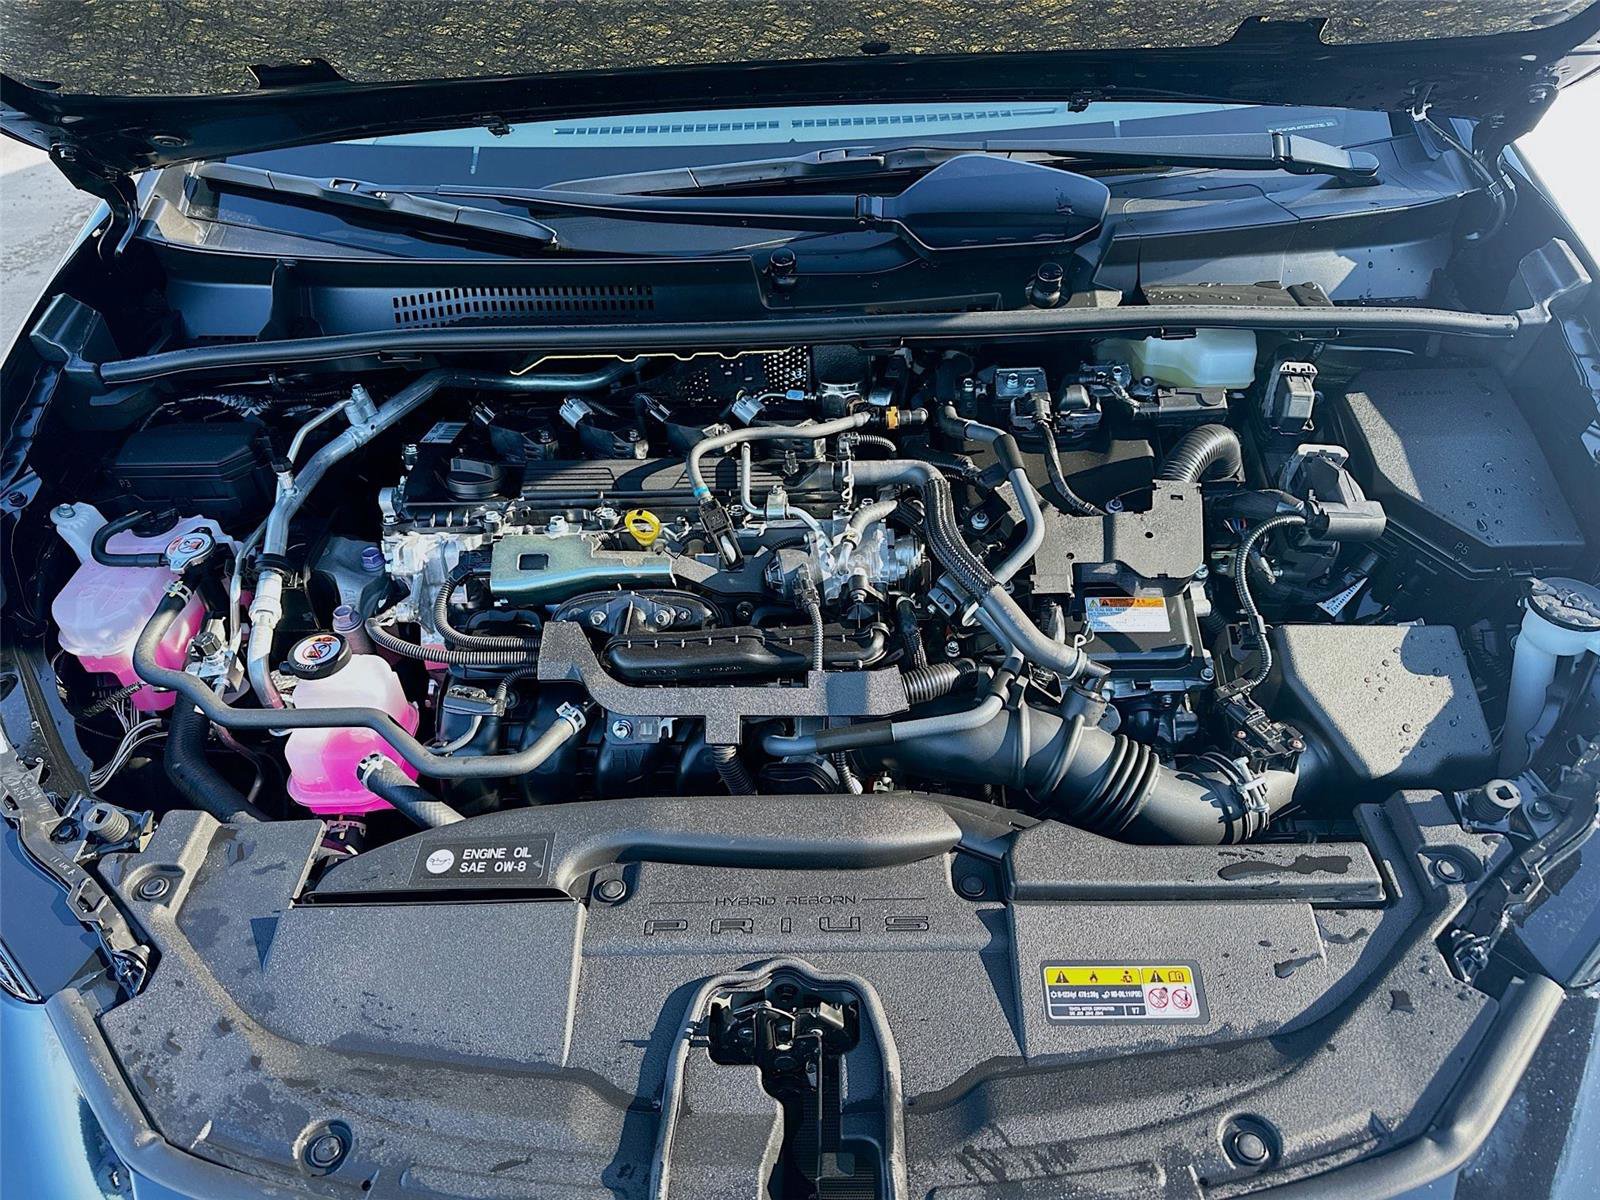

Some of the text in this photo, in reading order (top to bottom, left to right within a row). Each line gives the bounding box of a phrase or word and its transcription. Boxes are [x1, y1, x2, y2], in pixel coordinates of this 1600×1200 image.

[462, 847, 532, 860] ENGINE OIL
[459, 861, 527, 873] SAE 0W-8
[714, 895, 857, 906] HYBRID REBORN
[643, 916, 930, 936] PRIUS
